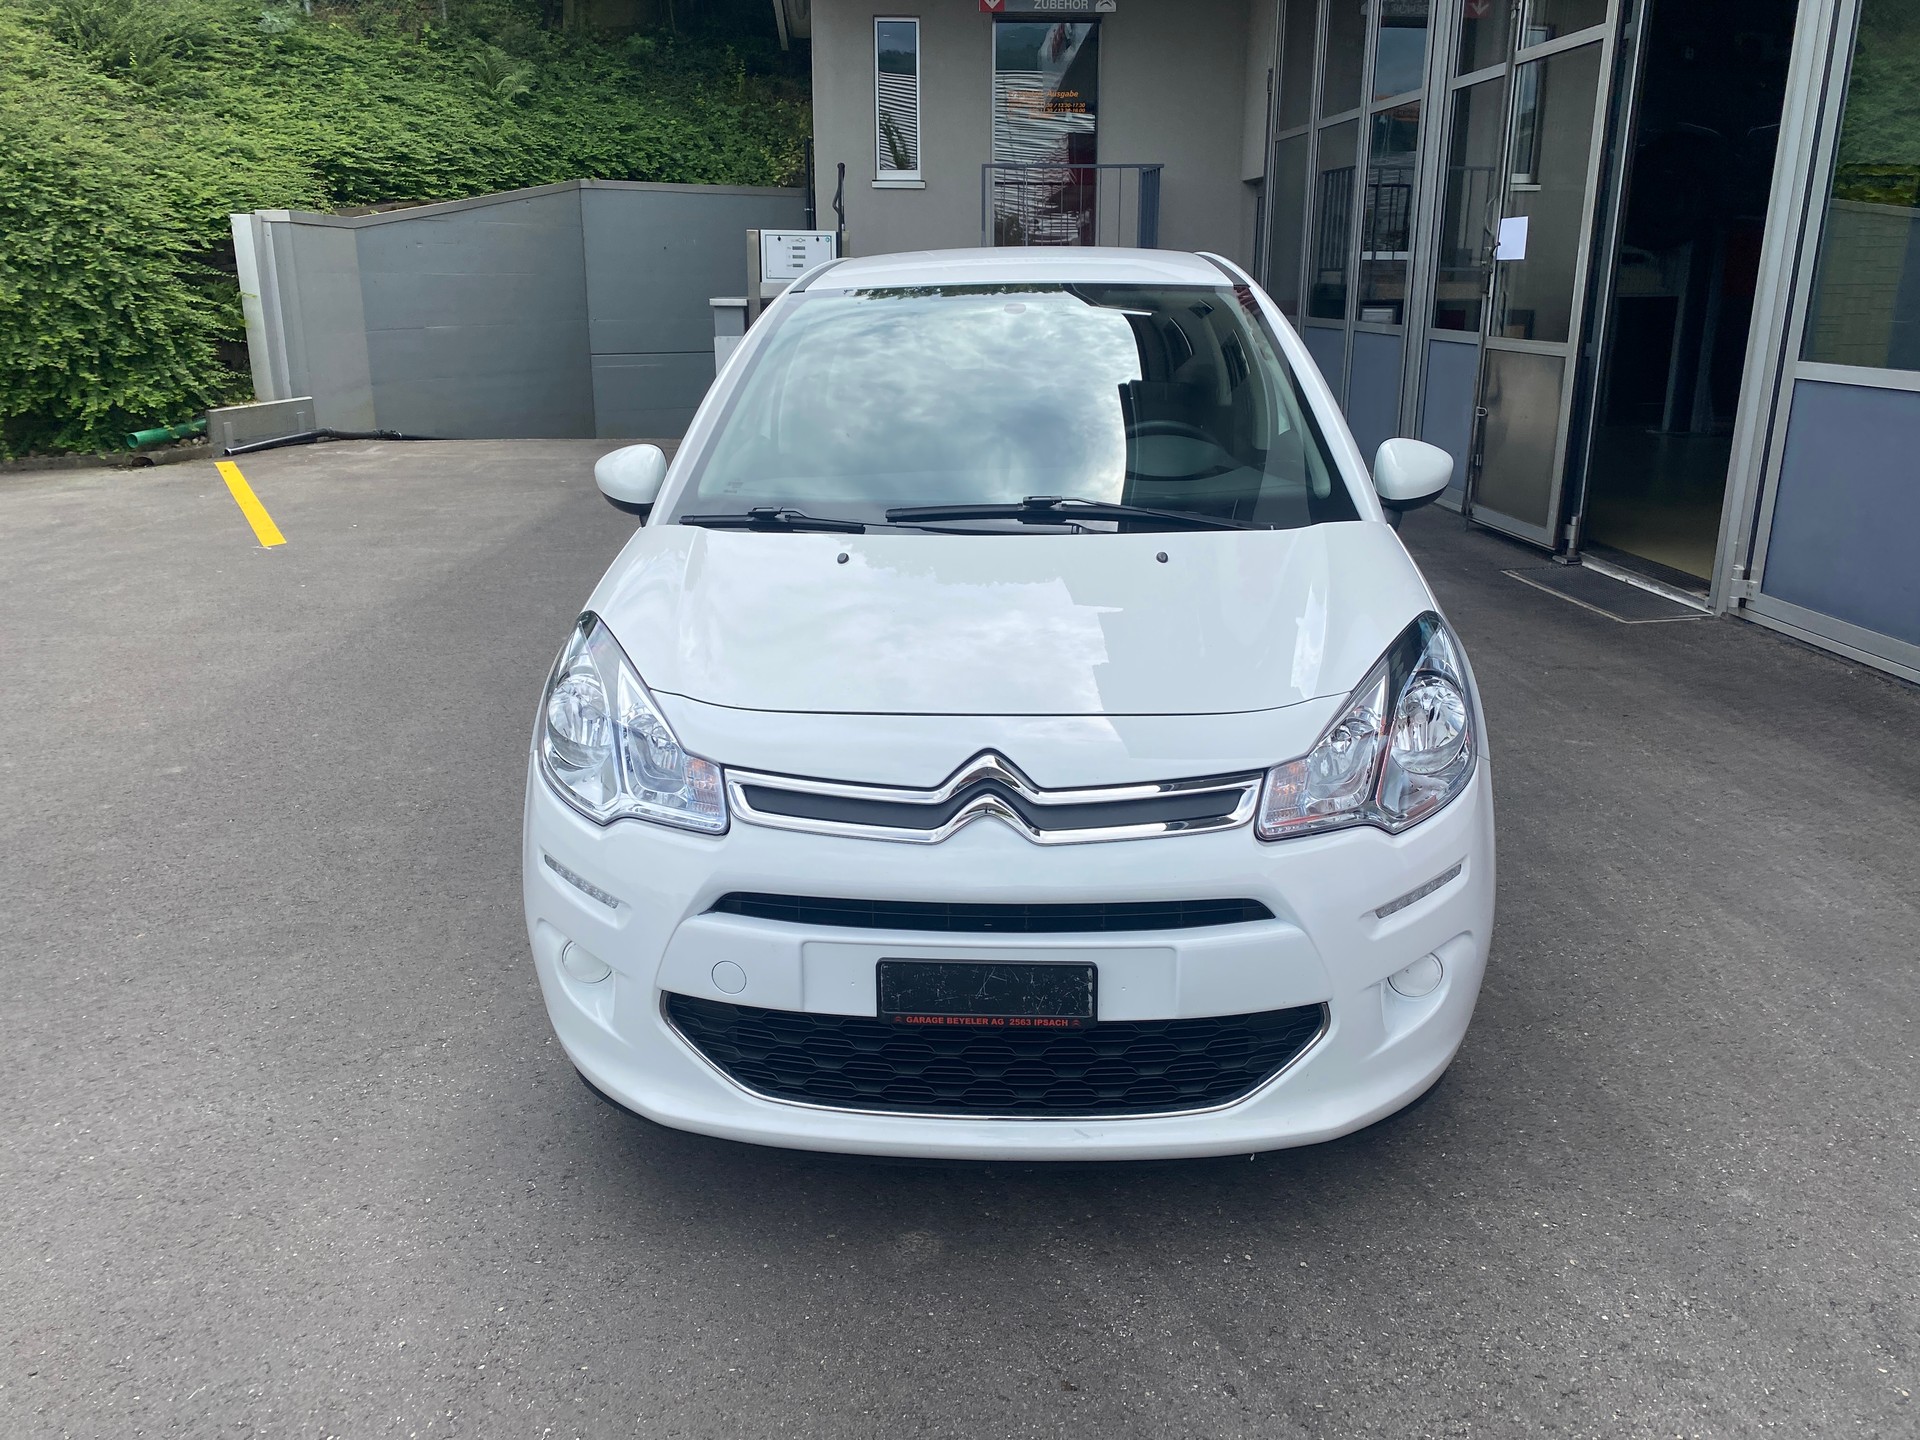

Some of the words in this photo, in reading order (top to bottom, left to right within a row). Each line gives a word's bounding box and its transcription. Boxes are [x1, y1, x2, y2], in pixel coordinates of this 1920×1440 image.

[1047, 90, 1079, 98] Ausgabe
[906, 1016, 944, 1024] GARAGE
[946, 1017, 989, 1025] BEYELER
[991, 1018, 1005, 1026] AG
[1009, 1018, 1032, 1026] 2563
[1034, 1019, 1069, 1027] IPSACH
